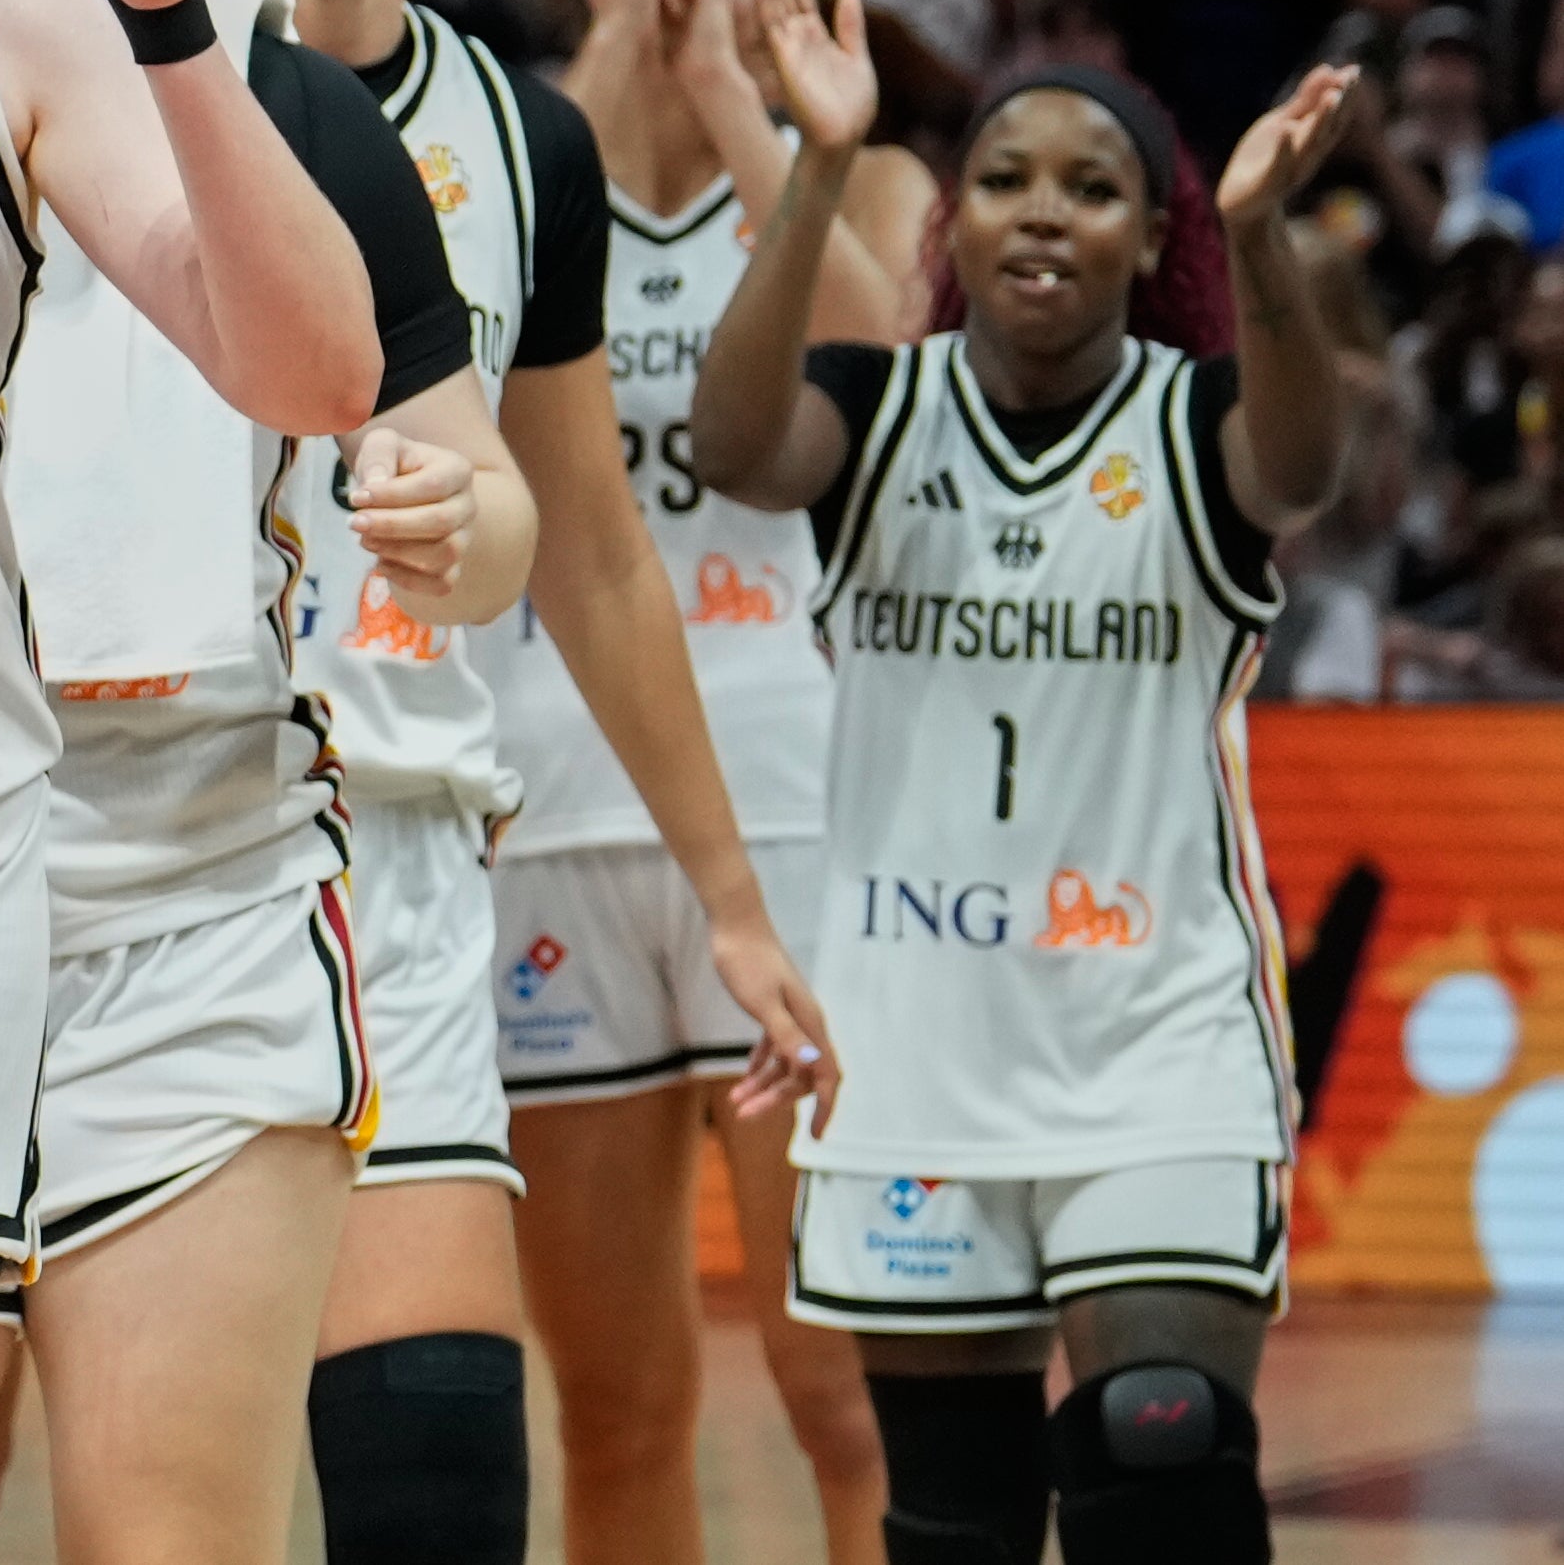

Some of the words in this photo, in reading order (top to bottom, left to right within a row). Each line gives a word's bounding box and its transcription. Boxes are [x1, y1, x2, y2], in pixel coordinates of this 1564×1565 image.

[853, 589, 1184, 663] DEUTSCHLAND
[993, 712, 1017, 820] 1
[860, 878, 1012, 948] ING
